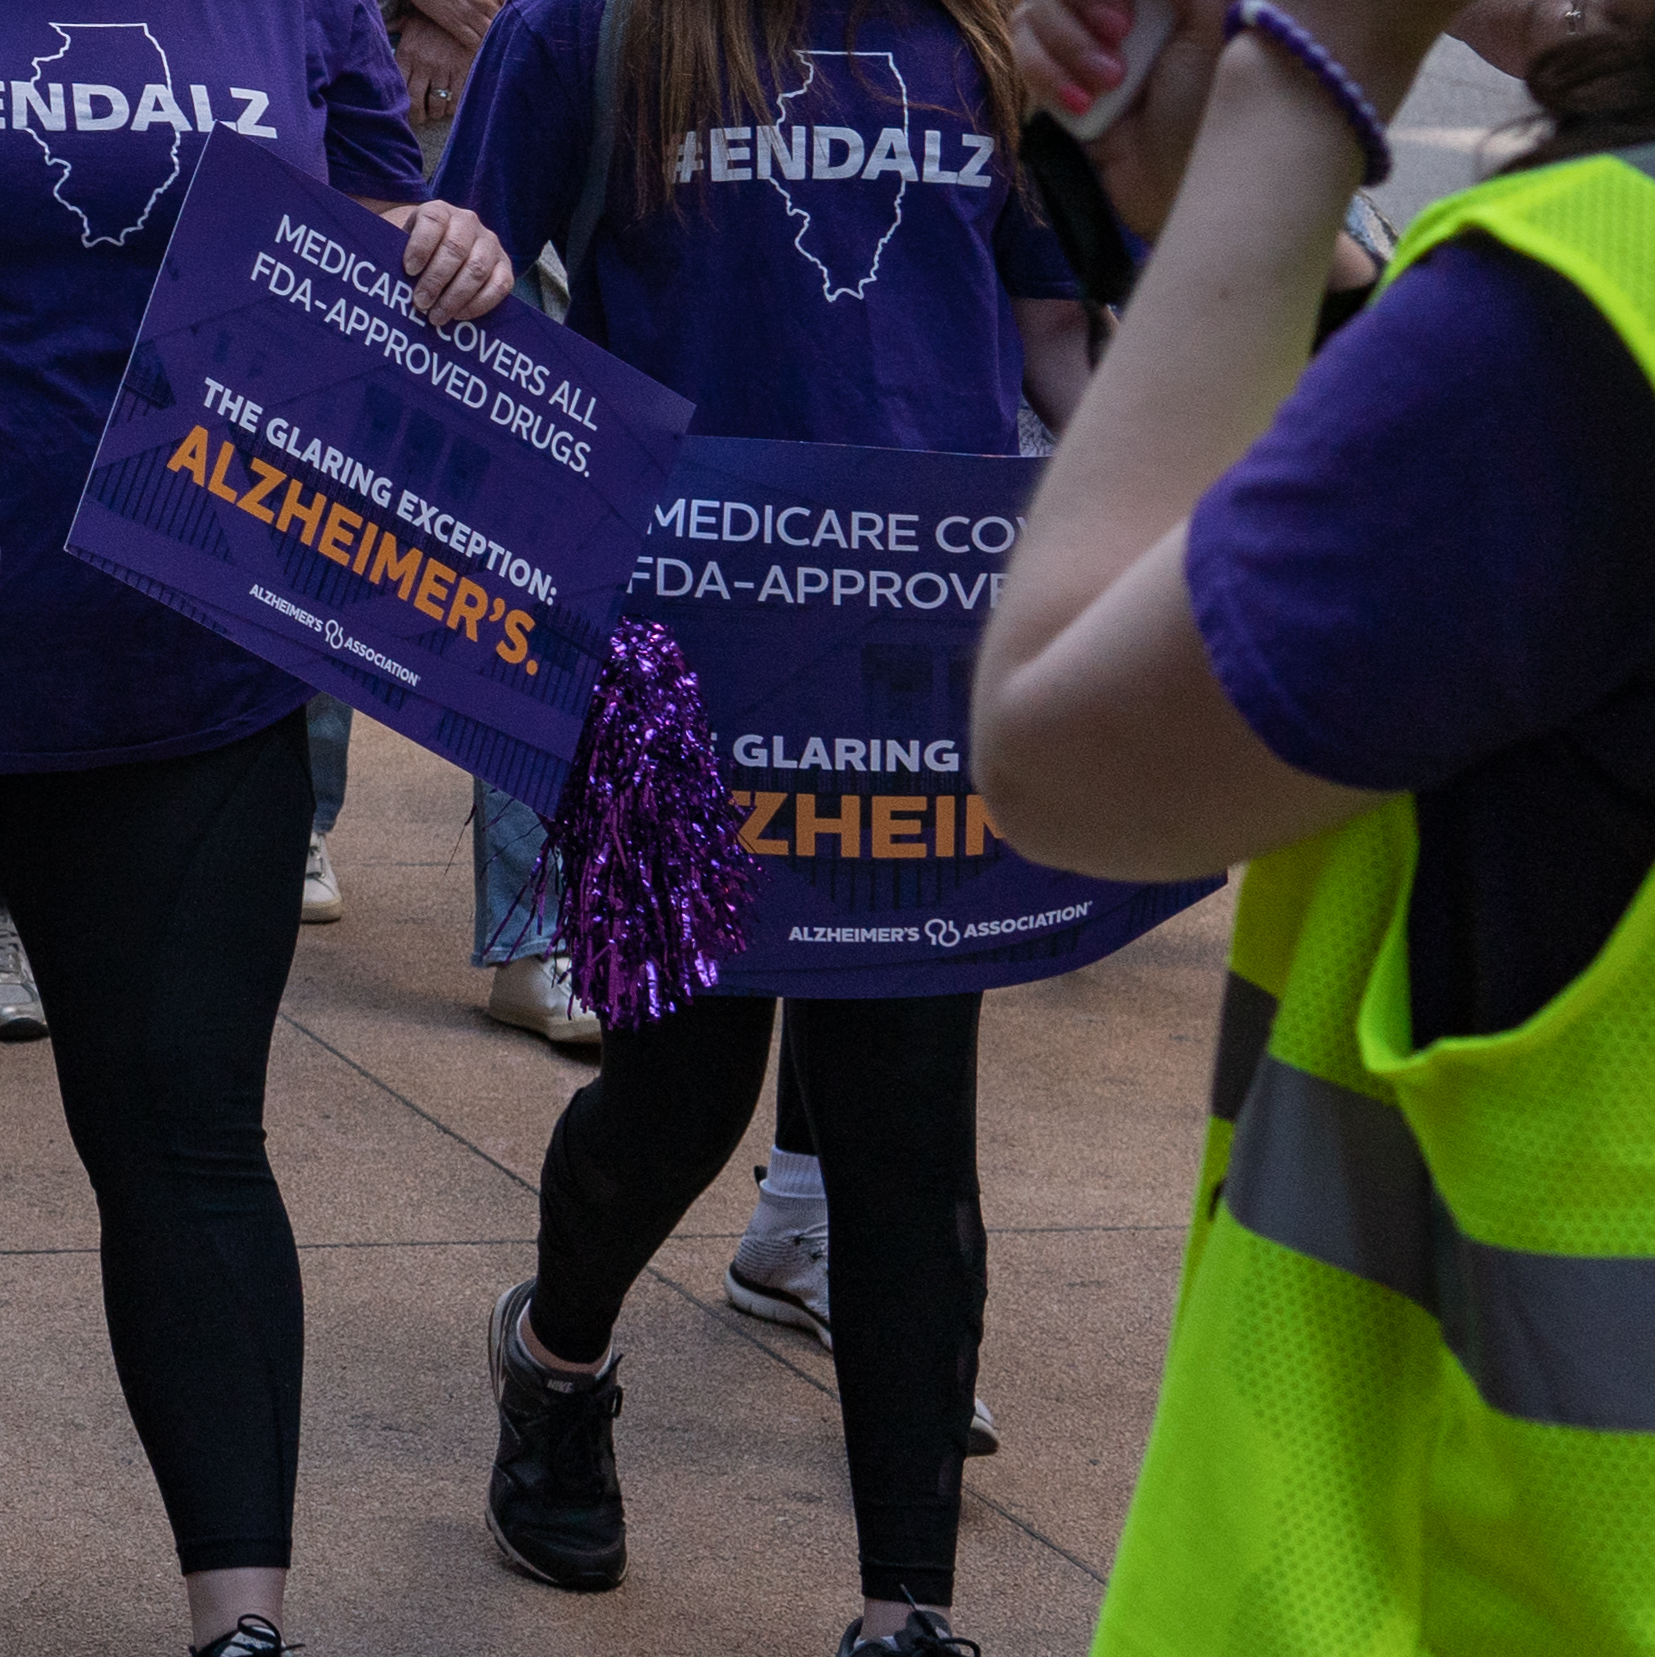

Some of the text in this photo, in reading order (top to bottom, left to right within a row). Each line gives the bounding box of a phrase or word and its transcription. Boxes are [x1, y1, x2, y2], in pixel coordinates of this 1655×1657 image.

[669, 125, 995, 188] #ENDALZ
[250, 251, 591, 477] FDA-APPROVED DRUGS.
[548, 380, 598, 432] ALL
[203, 377, 557, 607] THE GLARING EXCEPTION:
[166, 424, 539, 676] ALZHEIMER'S.
[647, 498, 920, 552] MEDICARE
[249, 583, 419, 686] ALZHEIMER'S ASSOCIATION
[732, 734, 960, 773] GLARING
[788, 900, 1091, 944] ALZHEIMER'S ASSOCIATION
